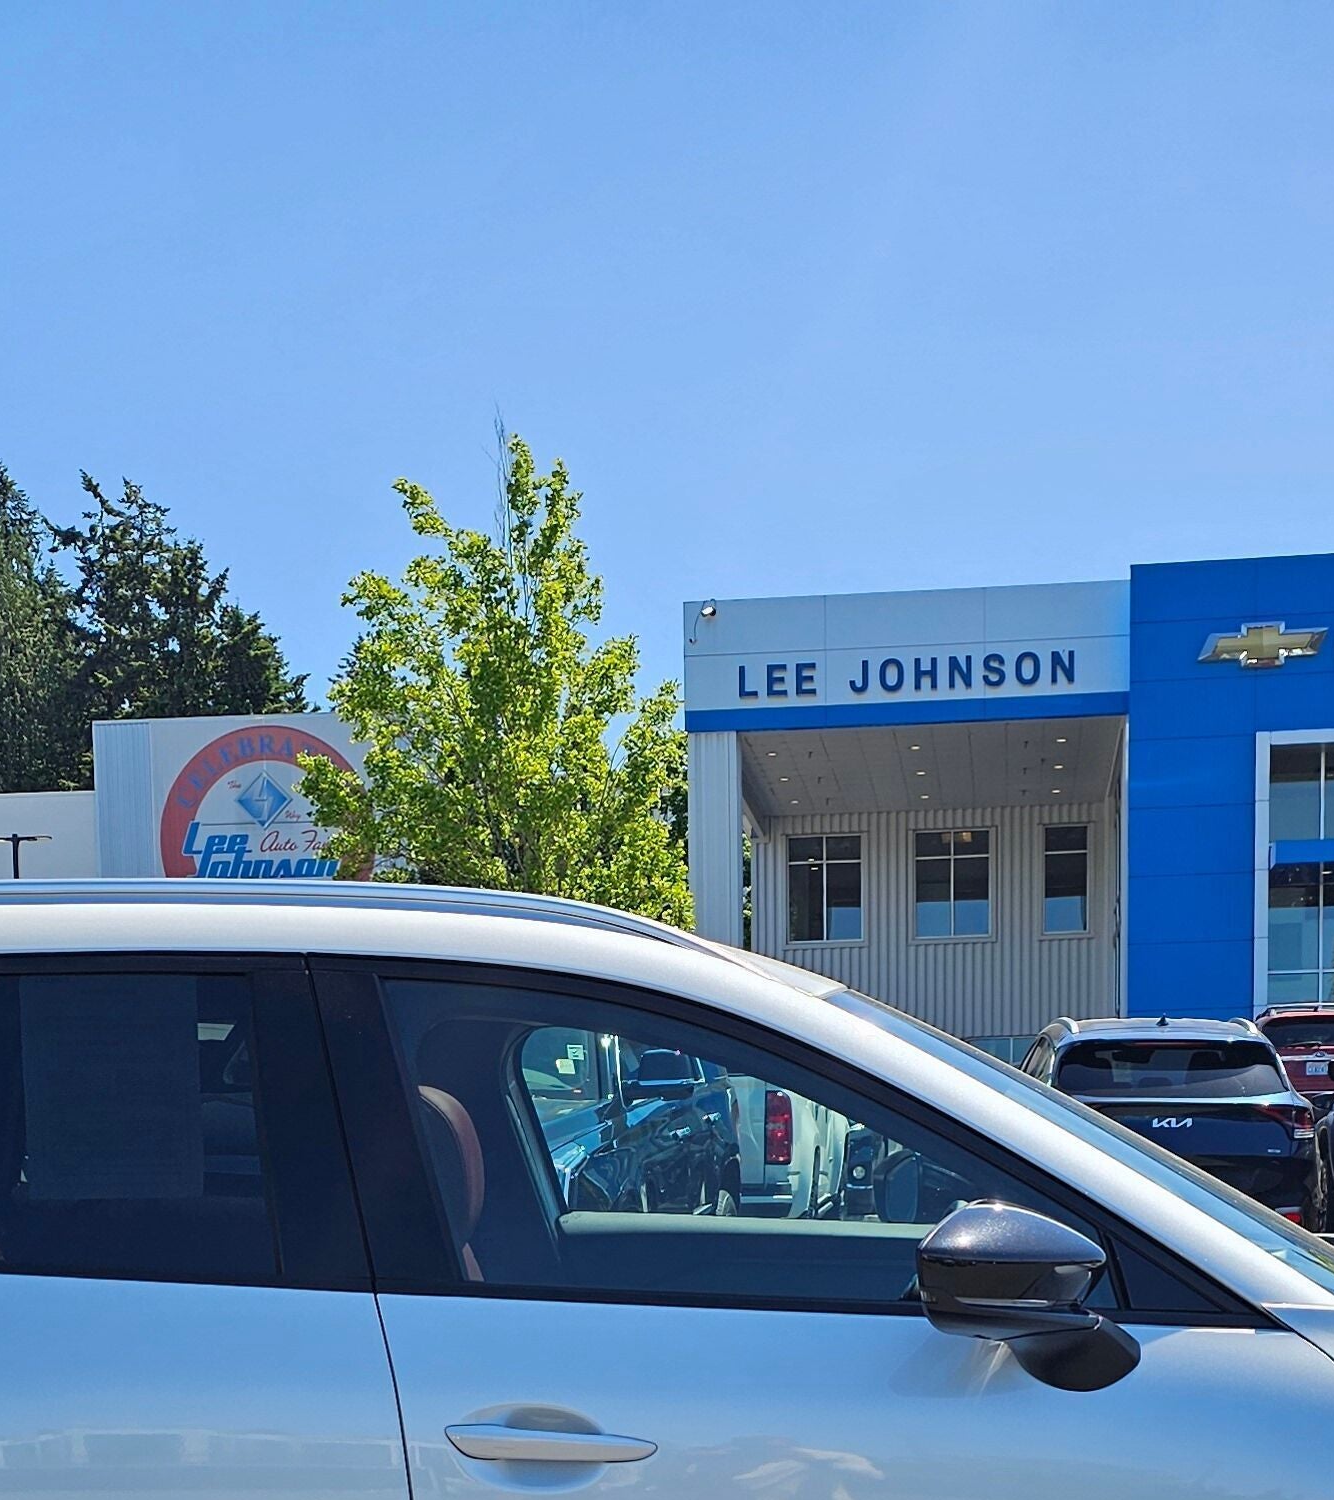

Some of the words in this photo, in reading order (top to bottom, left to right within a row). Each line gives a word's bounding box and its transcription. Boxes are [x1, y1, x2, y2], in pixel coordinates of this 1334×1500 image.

[738, 662, 817, 698] LEE
[848, 650, 1076, 693] JOHNSON
[183, 821, 253, 855] Lee
[259, 830, 298, 853] Auto
[196, 848, 341, 879] Johnson
